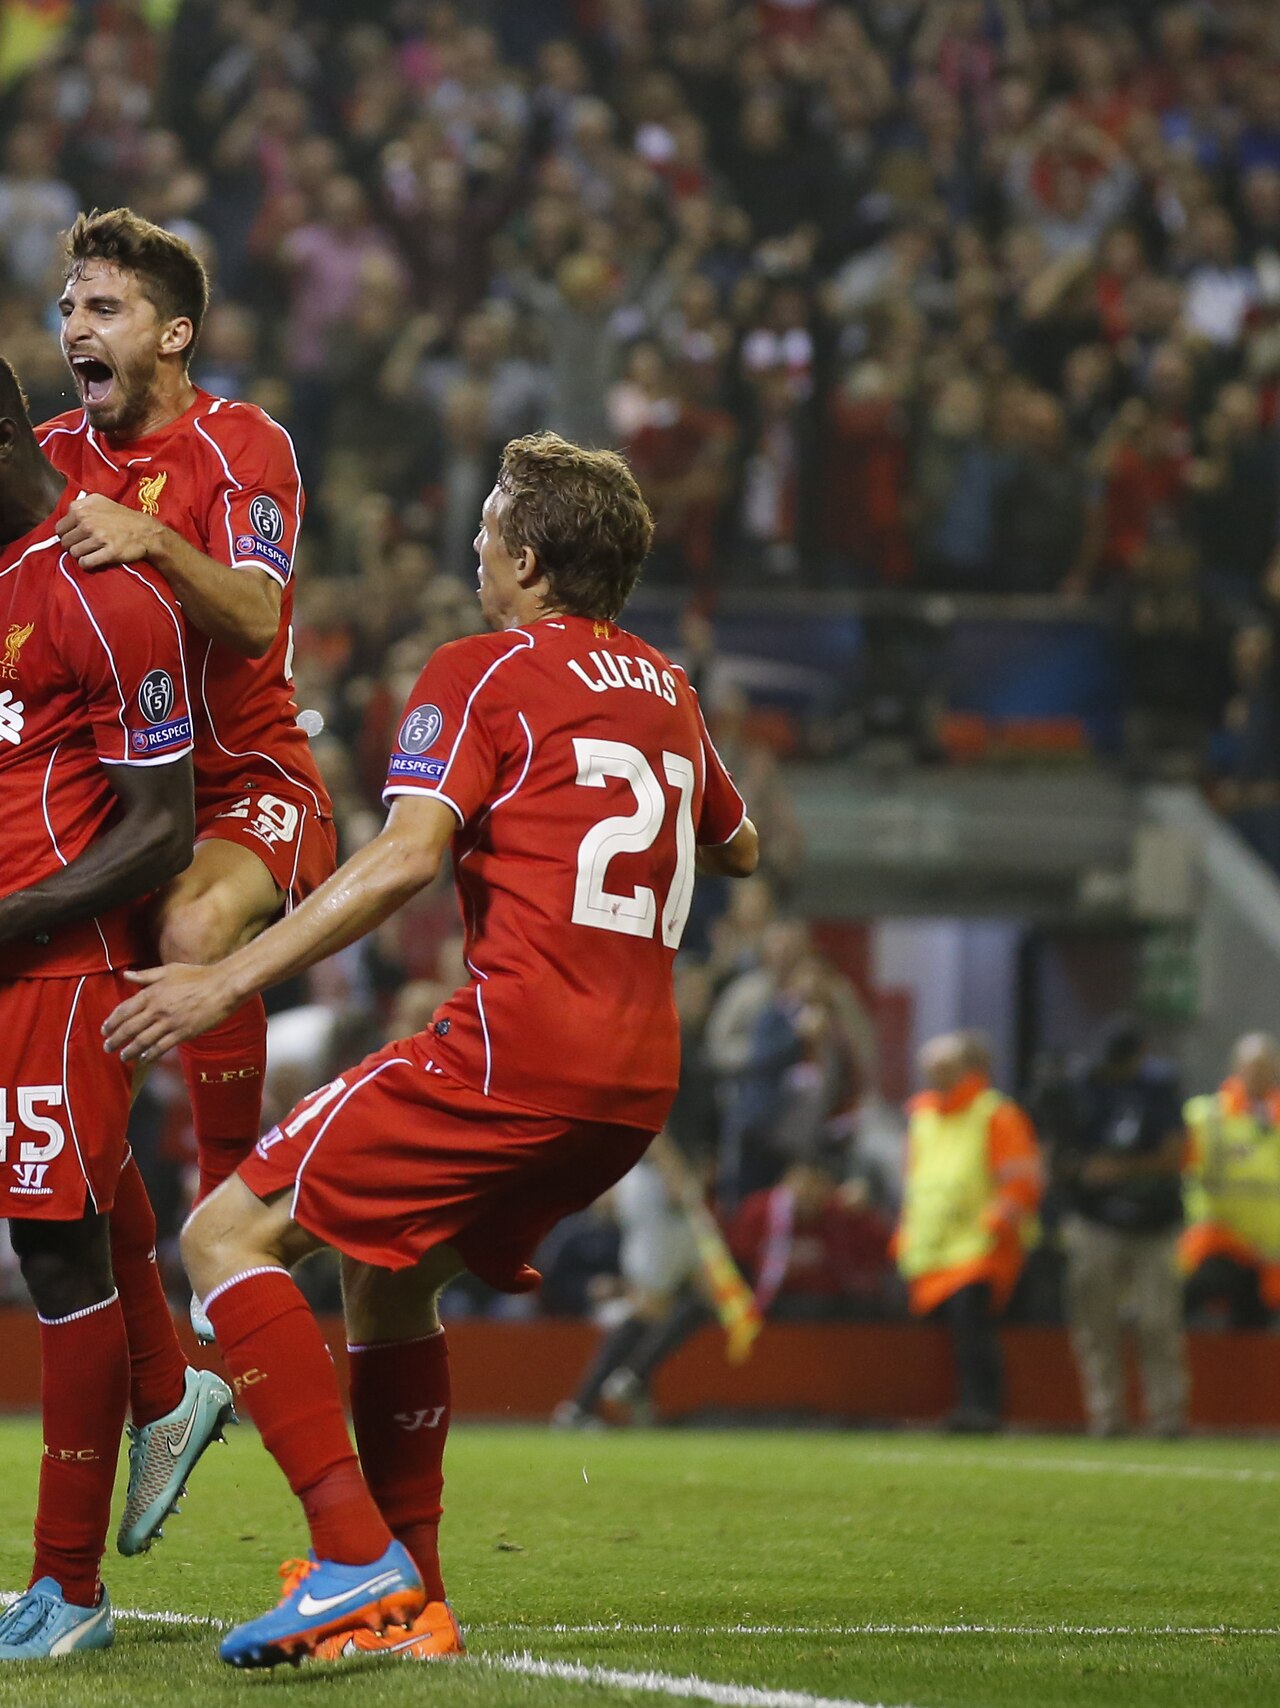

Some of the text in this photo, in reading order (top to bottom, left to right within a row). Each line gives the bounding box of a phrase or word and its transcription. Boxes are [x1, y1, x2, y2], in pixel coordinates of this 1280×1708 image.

[567, 649, 677, 707] LUCAS
[154, 695, 163, 710] 5
[148, 722, 190, 745] RESPECT
[412, 727, 424, 741] 5
[393, 759, 444, 775] RESPECT
[571, 737, 696, 951] 21
[200, 1066, 260, 1084] L.F.C.
[44, 1444, 100, 1461] L.F.C.
